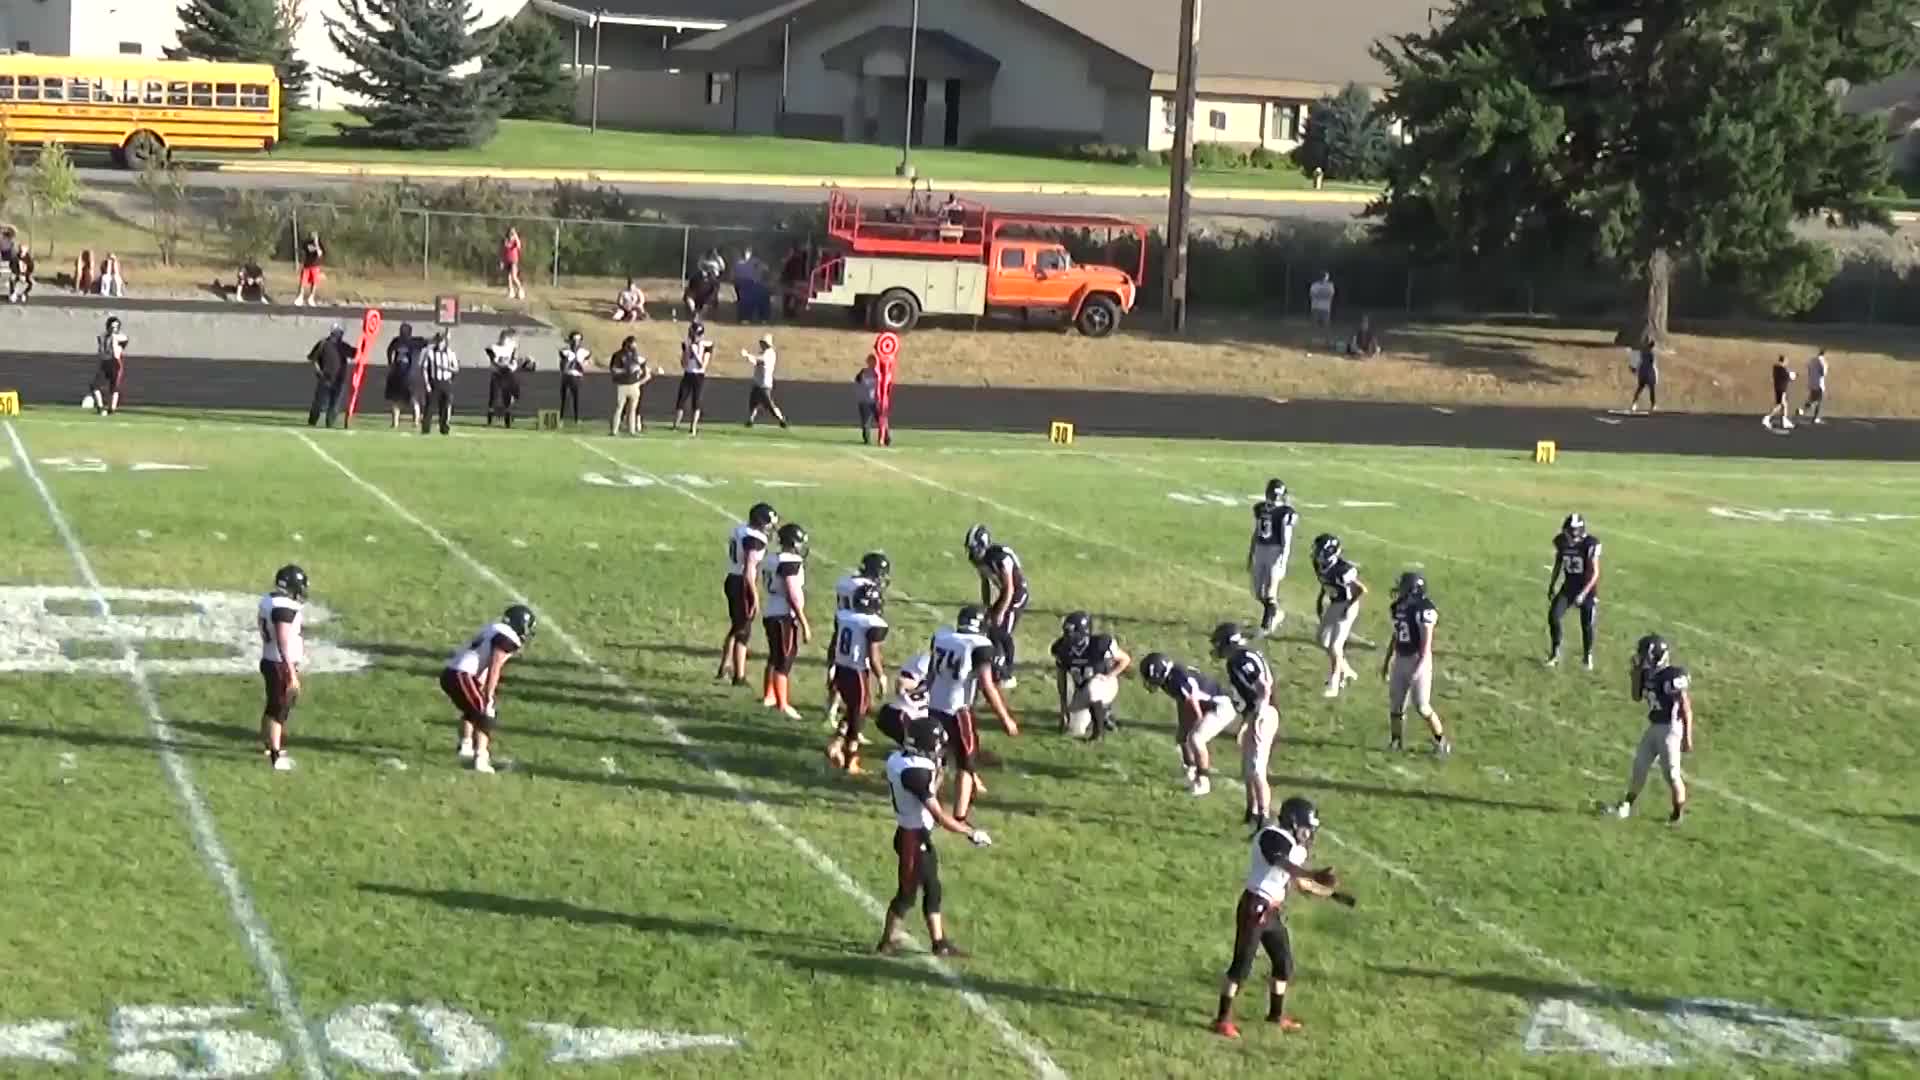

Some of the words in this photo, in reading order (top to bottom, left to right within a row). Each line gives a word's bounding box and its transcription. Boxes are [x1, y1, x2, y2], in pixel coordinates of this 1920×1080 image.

[1054, 425, 1069, 444] 30
[935, 646, 961, 681] 74
[108, 1003, 504, 1077] 50
